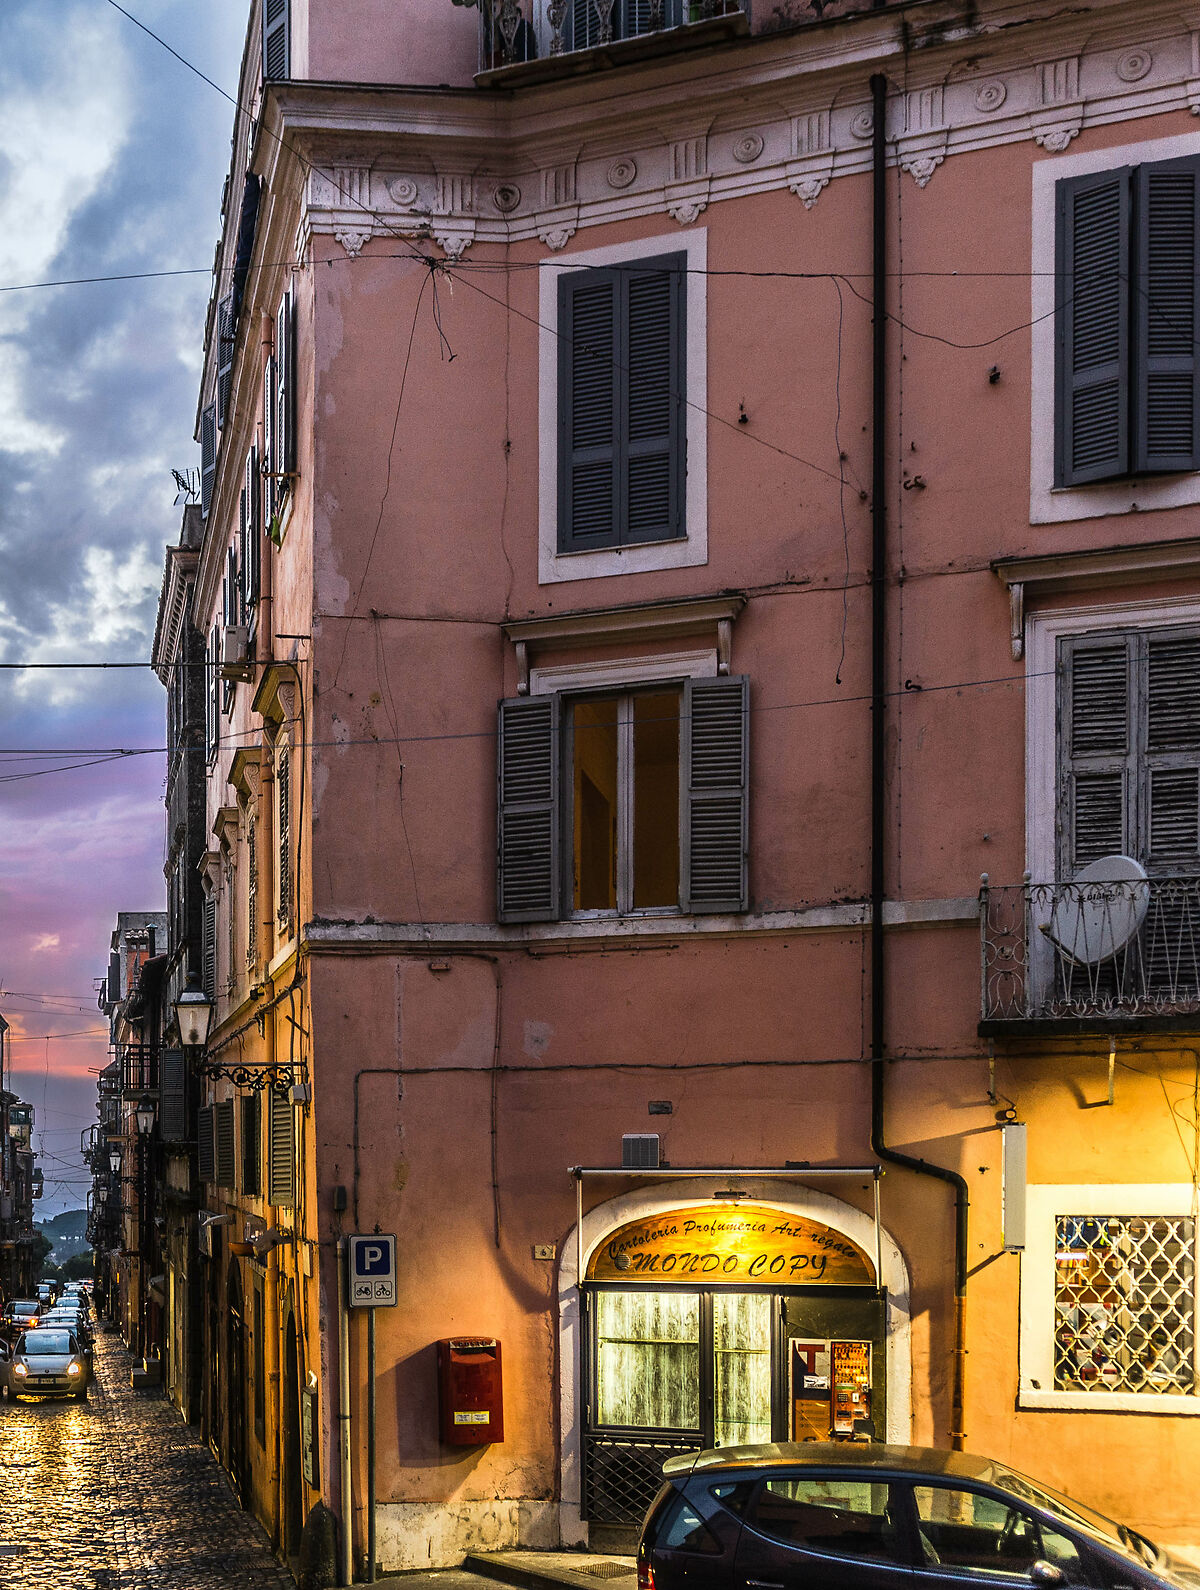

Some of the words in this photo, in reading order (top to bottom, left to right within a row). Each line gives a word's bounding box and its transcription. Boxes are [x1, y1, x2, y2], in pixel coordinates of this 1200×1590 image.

[607, 1225, 678, 1259] Cartoleria
[683, 1219, 766, 1236] Profumeria
[770, 1221, 802, 1238] Art.
[809, 1233, 856, 1258] regalo
[364, 1246, 382, 1270] P
[632, 1252, 740, 1274] MONDO
[749, 1254, 828, 1280] COPY
